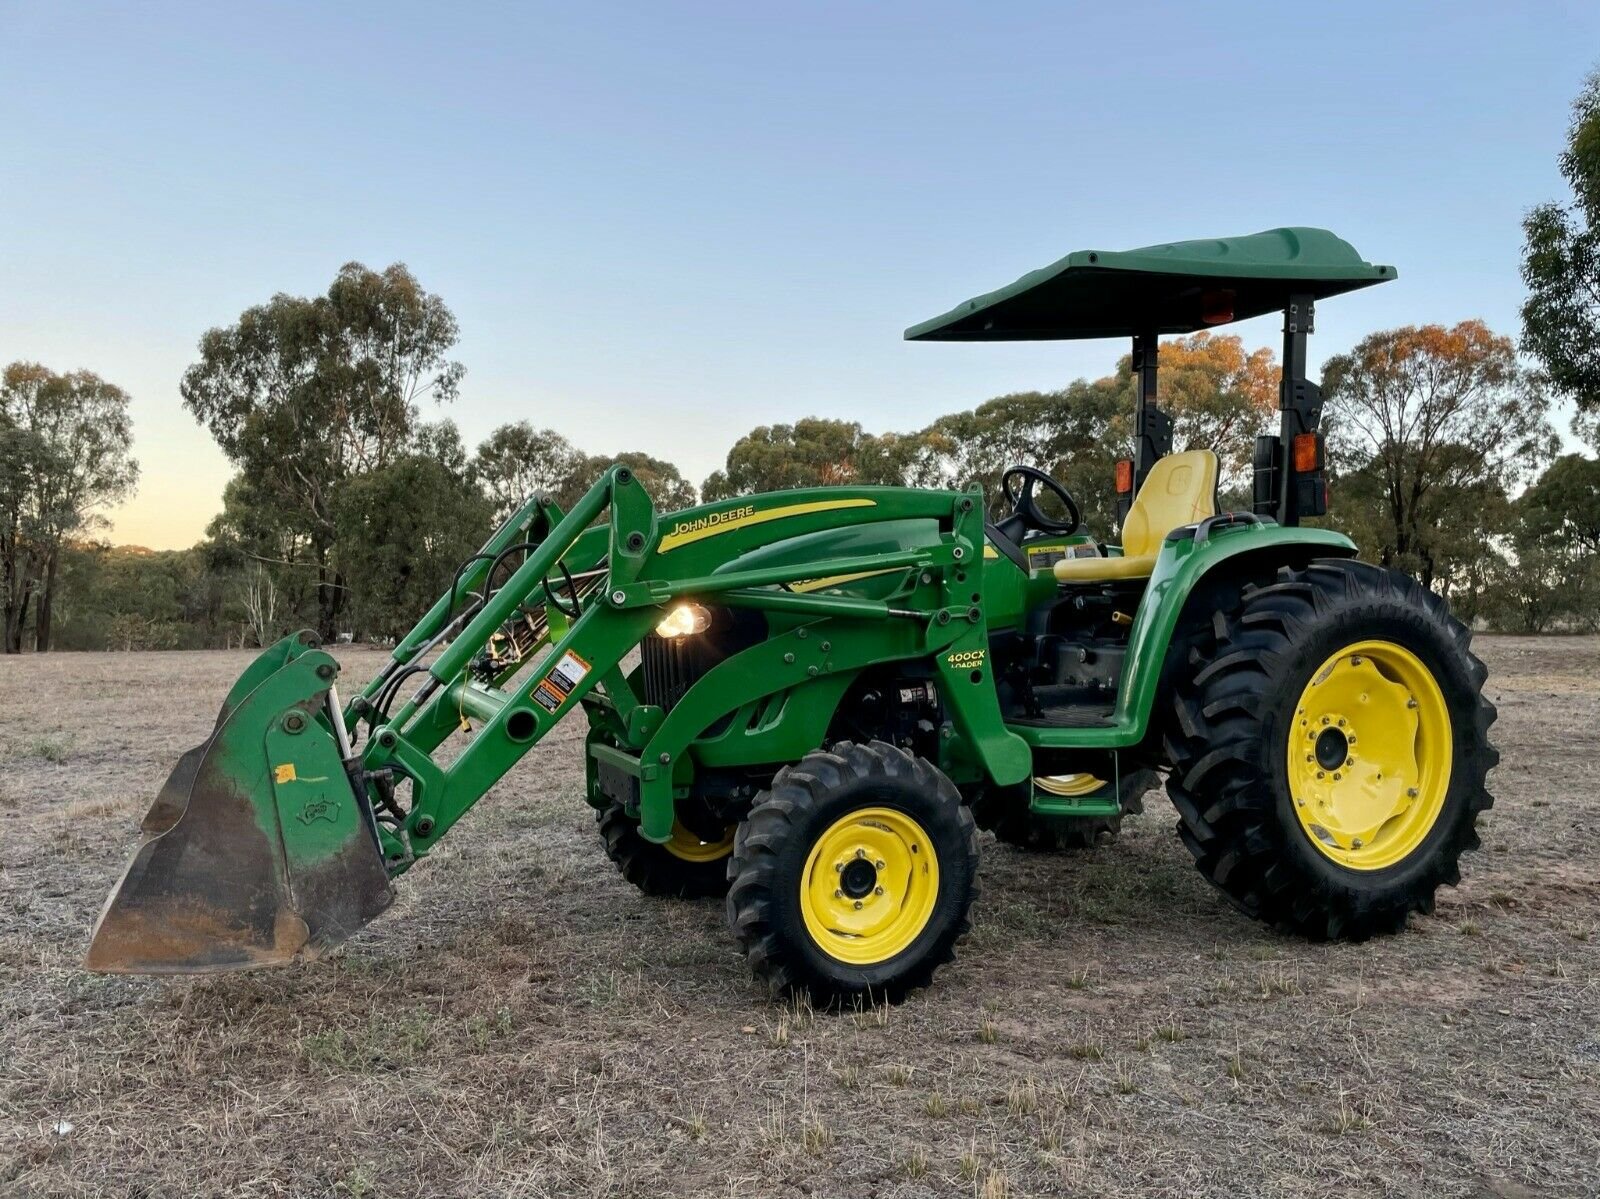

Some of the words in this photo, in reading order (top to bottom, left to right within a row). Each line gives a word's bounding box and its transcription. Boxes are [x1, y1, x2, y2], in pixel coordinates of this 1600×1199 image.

[671, 517, 707, 536] JOHN
[708, 505, 754, 526] DEERE
[947, 650, 985, 662] 400CX
